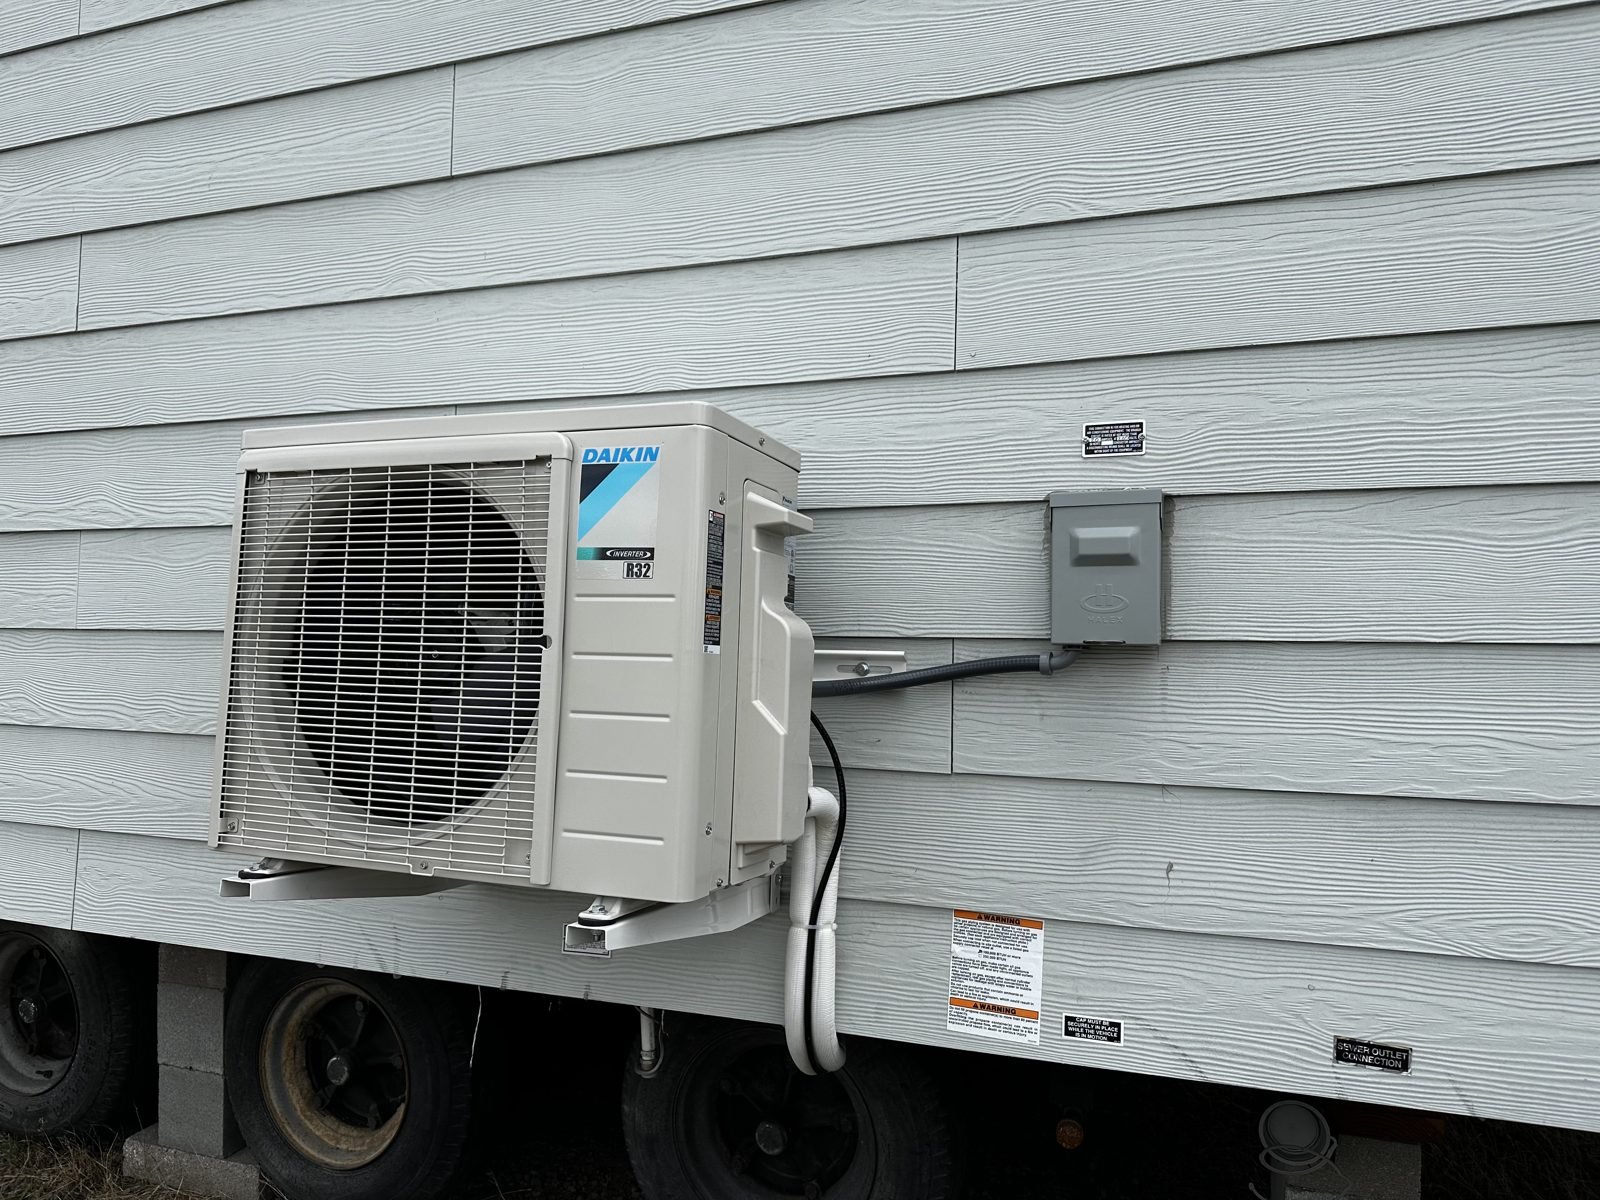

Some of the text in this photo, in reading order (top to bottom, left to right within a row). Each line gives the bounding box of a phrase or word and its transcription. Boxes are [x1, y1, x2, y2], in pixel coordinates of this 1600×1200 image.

[582, 447, 660, 463] DAIKIN
[626, 563, 651, 578] R32
[983, 915, 1020, 925] WARNING
[980, 1004, 1016, 1014] WARNING
[1338, 1042, 1408, 1060] SEWER OUTLET
[1342, 1052, 1402, 1068] CONNECTION
